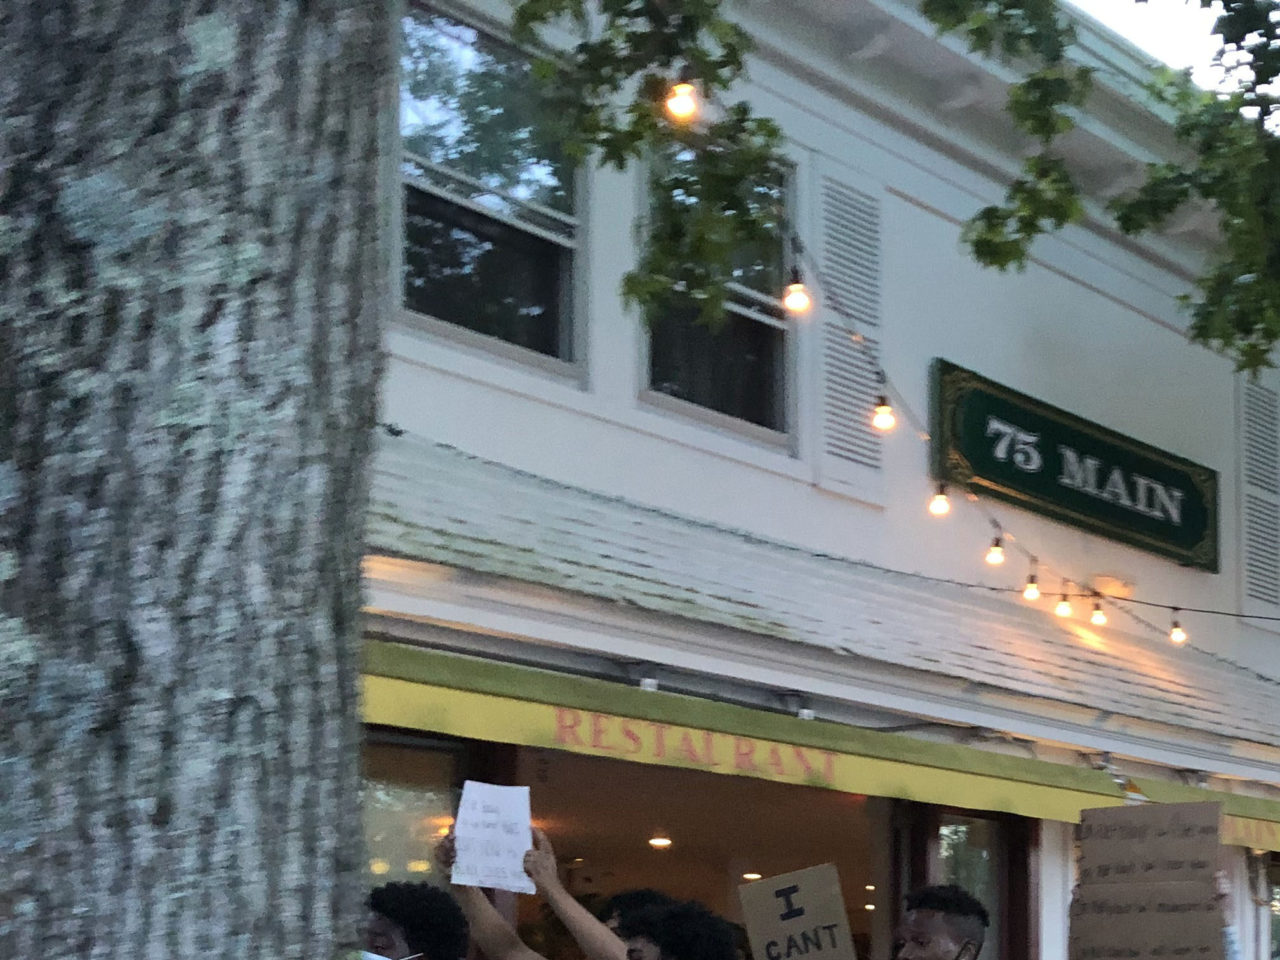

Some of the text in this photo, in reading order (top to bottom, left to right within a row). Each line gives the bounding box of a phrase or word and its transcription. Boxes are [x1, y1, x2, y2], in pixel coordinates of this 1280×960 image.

[984, 415, 1185, 526] 75 MAIN
[775, 884, 805, 921] I
